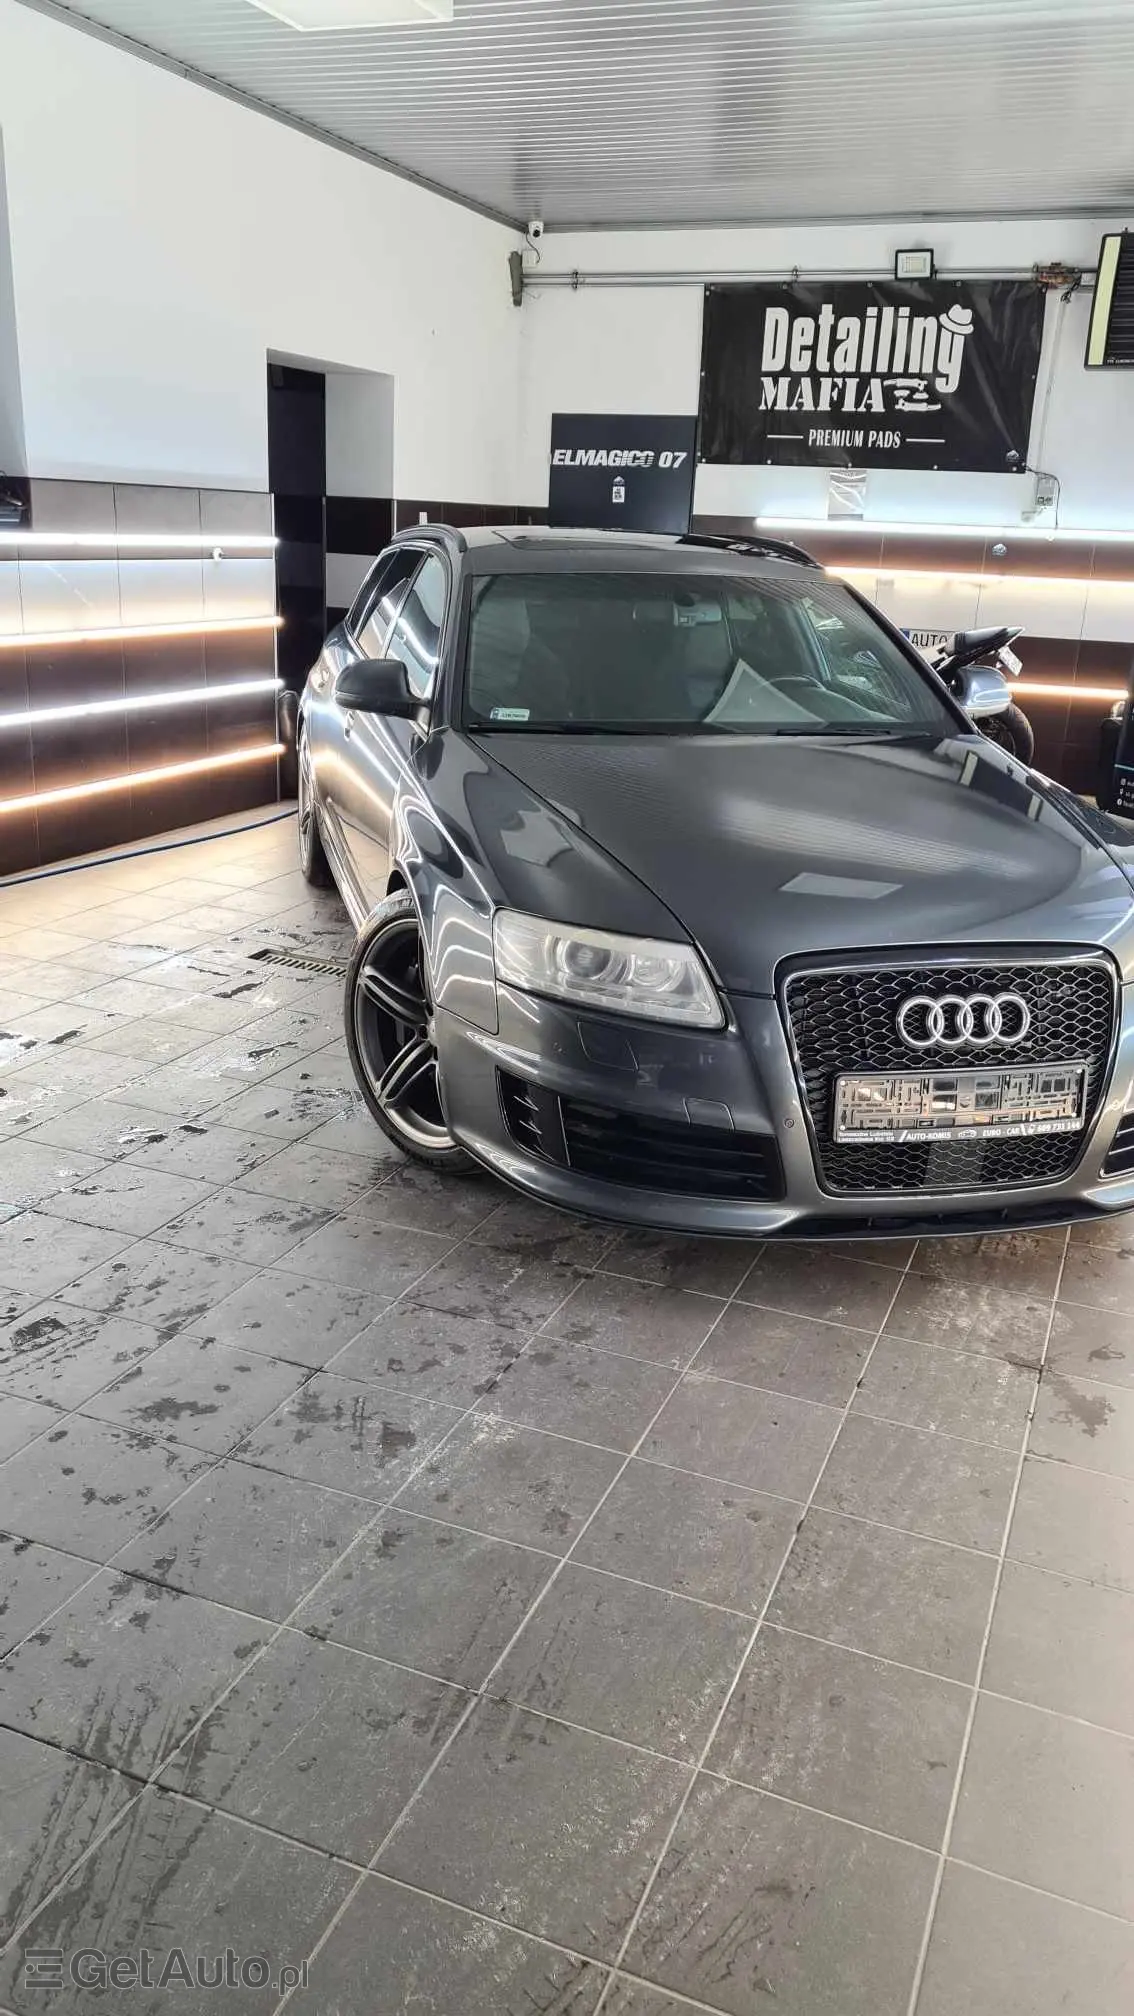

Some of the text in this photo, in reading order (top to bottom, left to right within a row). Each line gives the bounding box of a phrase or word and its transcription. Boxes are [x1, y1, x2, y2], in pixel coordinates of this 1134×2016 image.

[761, 304, 966, 393] Detailing
[758, 376, 886, 413] MAFIA
[808, 428, 901, 449] PREMIUM PADS
[552, 448, 688, 469] ELMAGICO 07
[911, 631, 948, 648] AUTO
